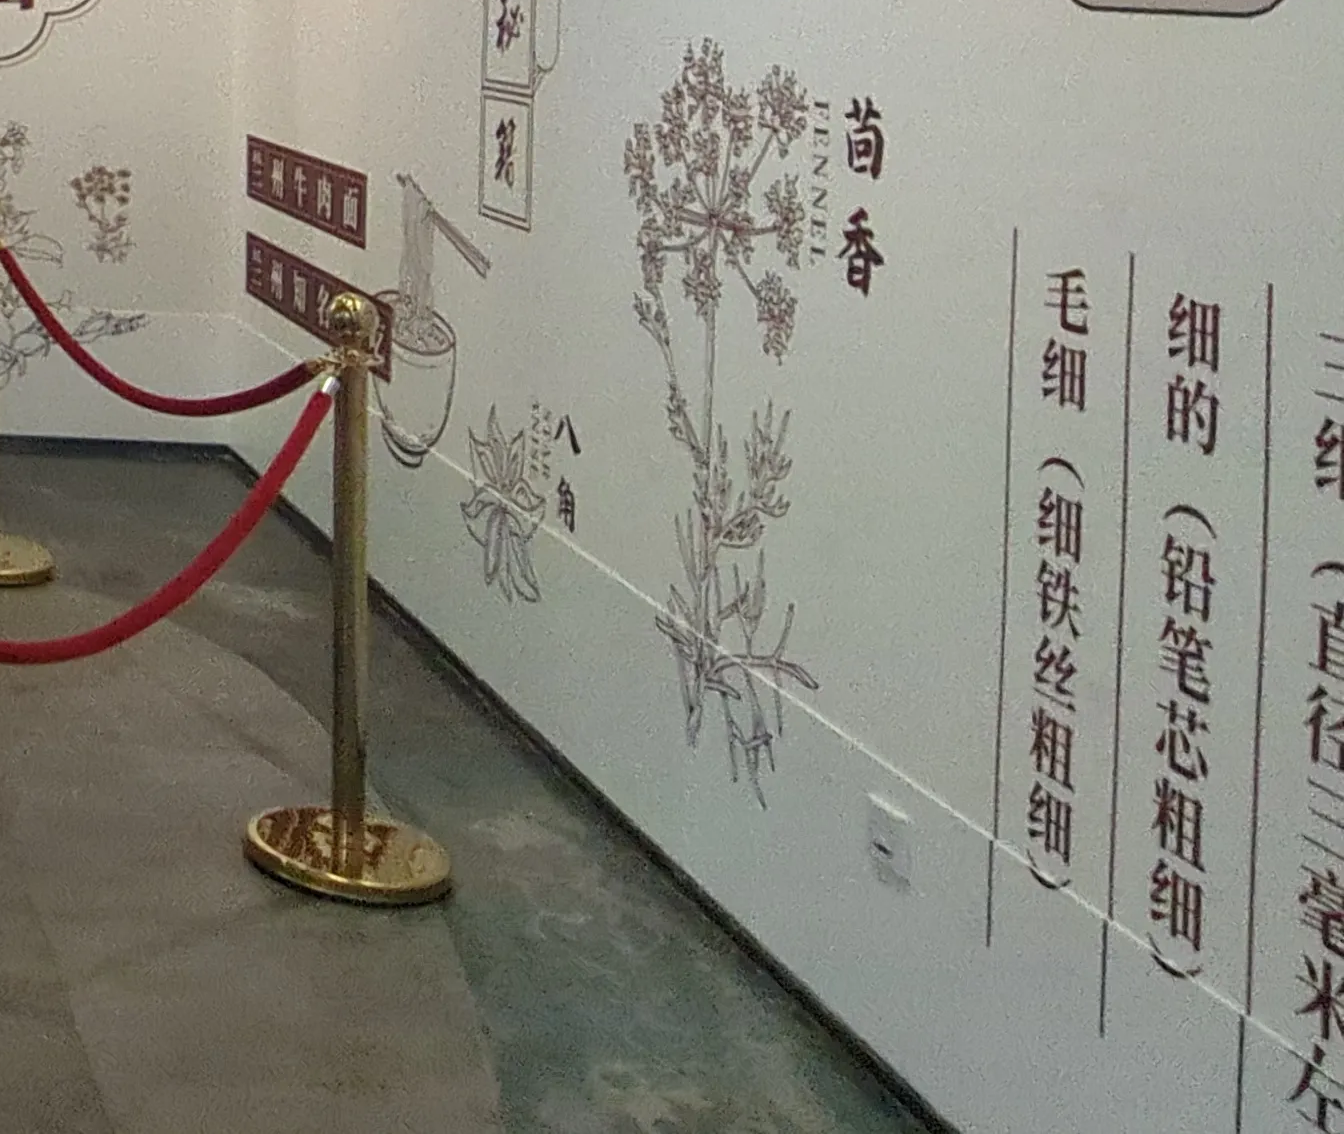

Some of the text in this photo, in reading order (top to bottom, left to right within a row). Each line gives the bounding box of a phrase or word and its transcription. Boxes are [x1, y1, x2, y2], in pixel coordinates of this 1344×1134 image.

[810, 99, 831, 268] FENNEL
[837, 97, 886, 298] 茴香
[554, 413, 581, 534] 八角
